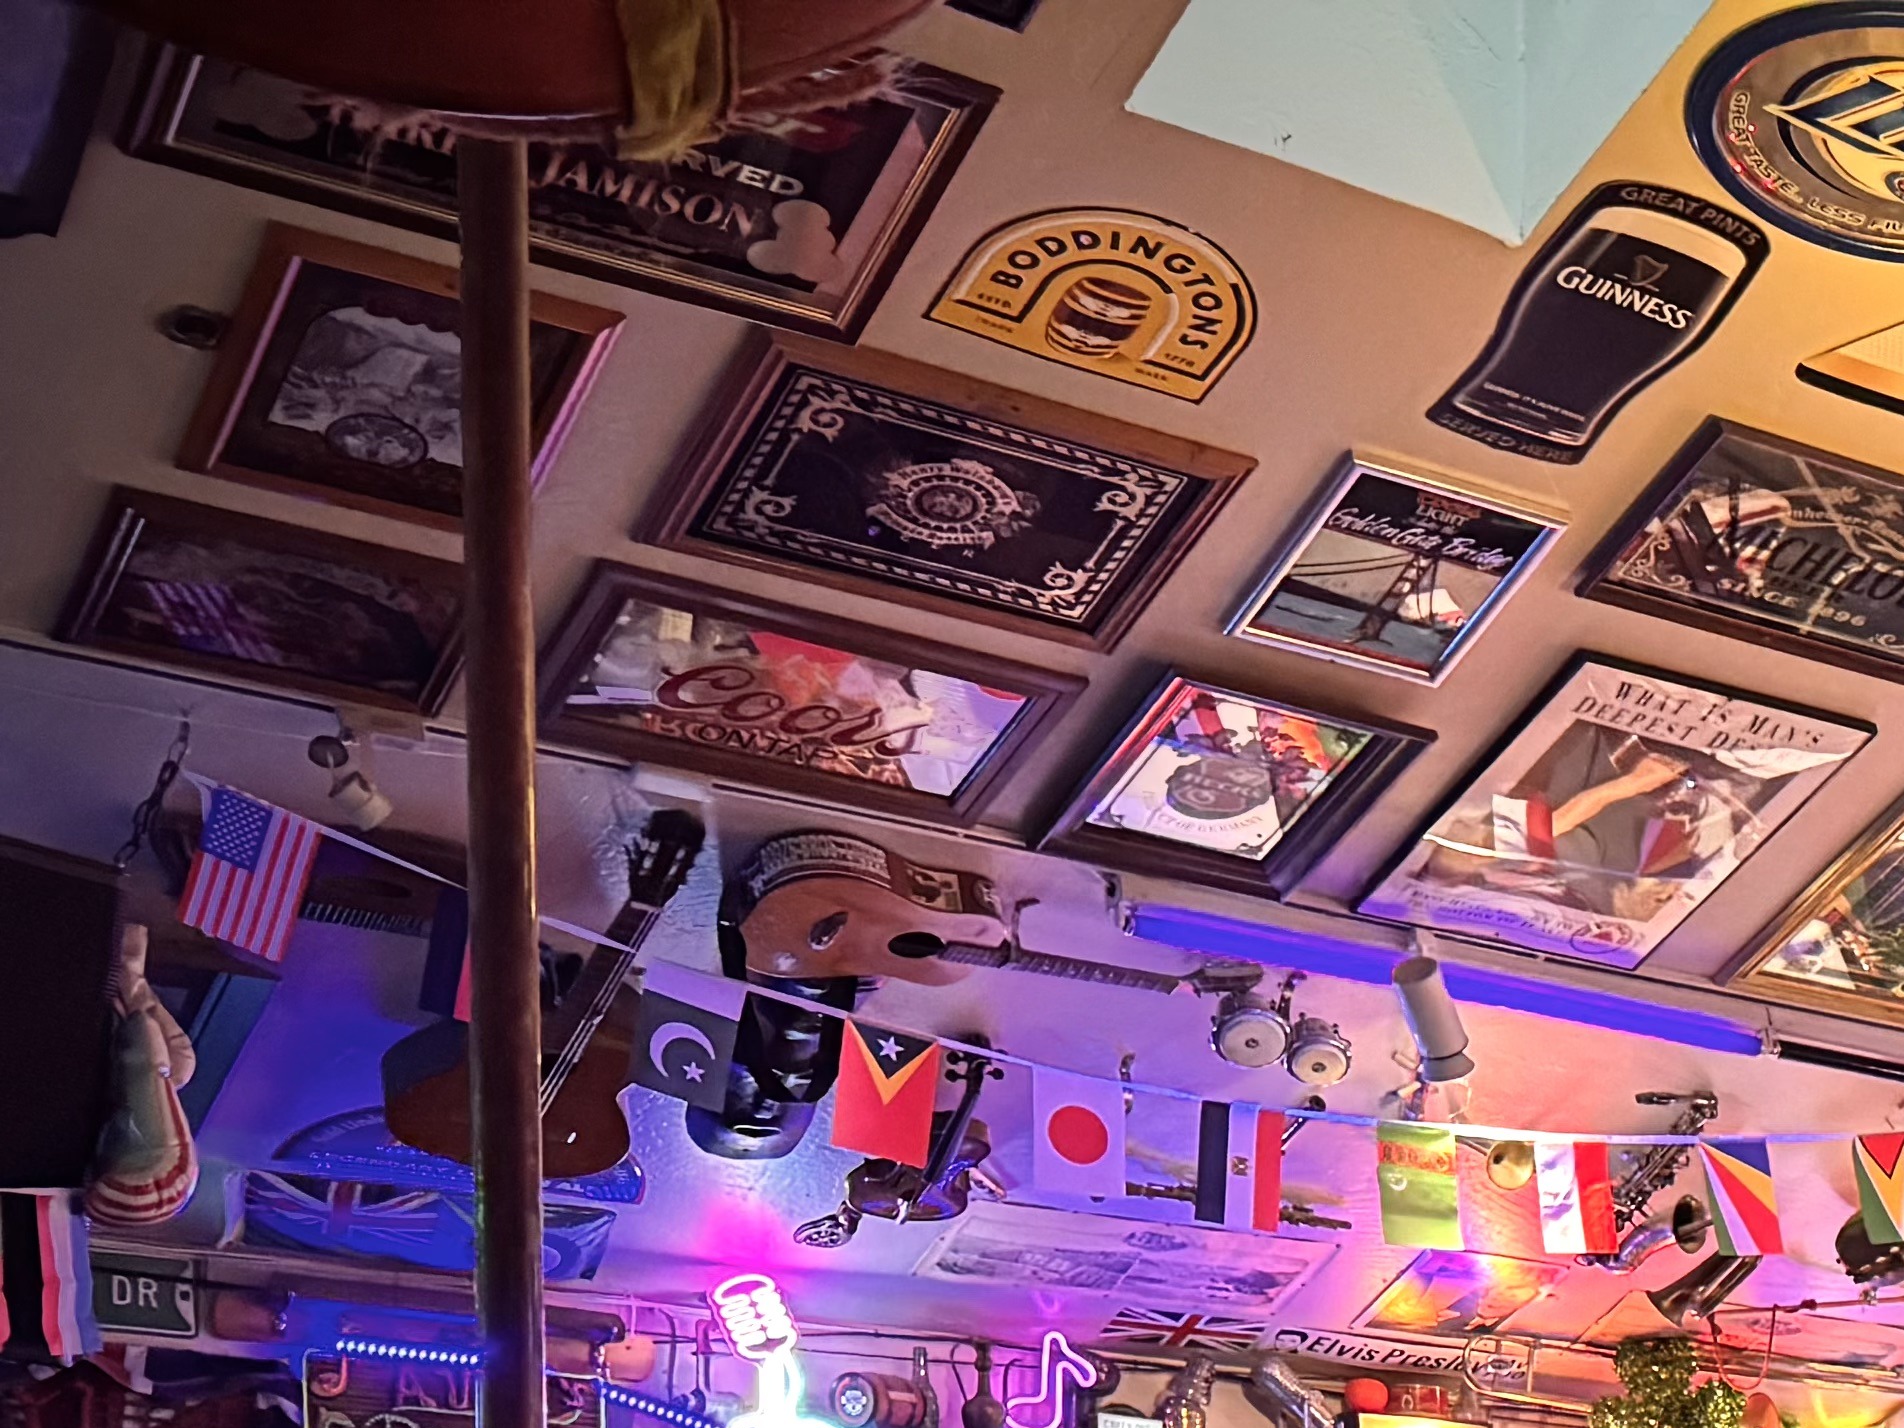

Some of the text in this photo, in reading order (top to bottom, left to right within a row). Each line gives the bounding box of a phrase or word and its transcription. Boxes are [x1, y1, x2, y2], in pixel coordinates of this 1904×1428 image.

[1620, 186, 1761, 248] GREAT PINTS
[990, 229, 1224, 351] BODDINGTONS
[1555, 265, 1696, 331] GUINNESS
[656, 663, 931, 759] Coors
[1570, 695, 1700, 743] DEEPEST
[1615, 680, 1698, 719] WHAT
[113, 1274, 158, 1309] DR
[1313, 1335, 1376, 1363] Elvis
